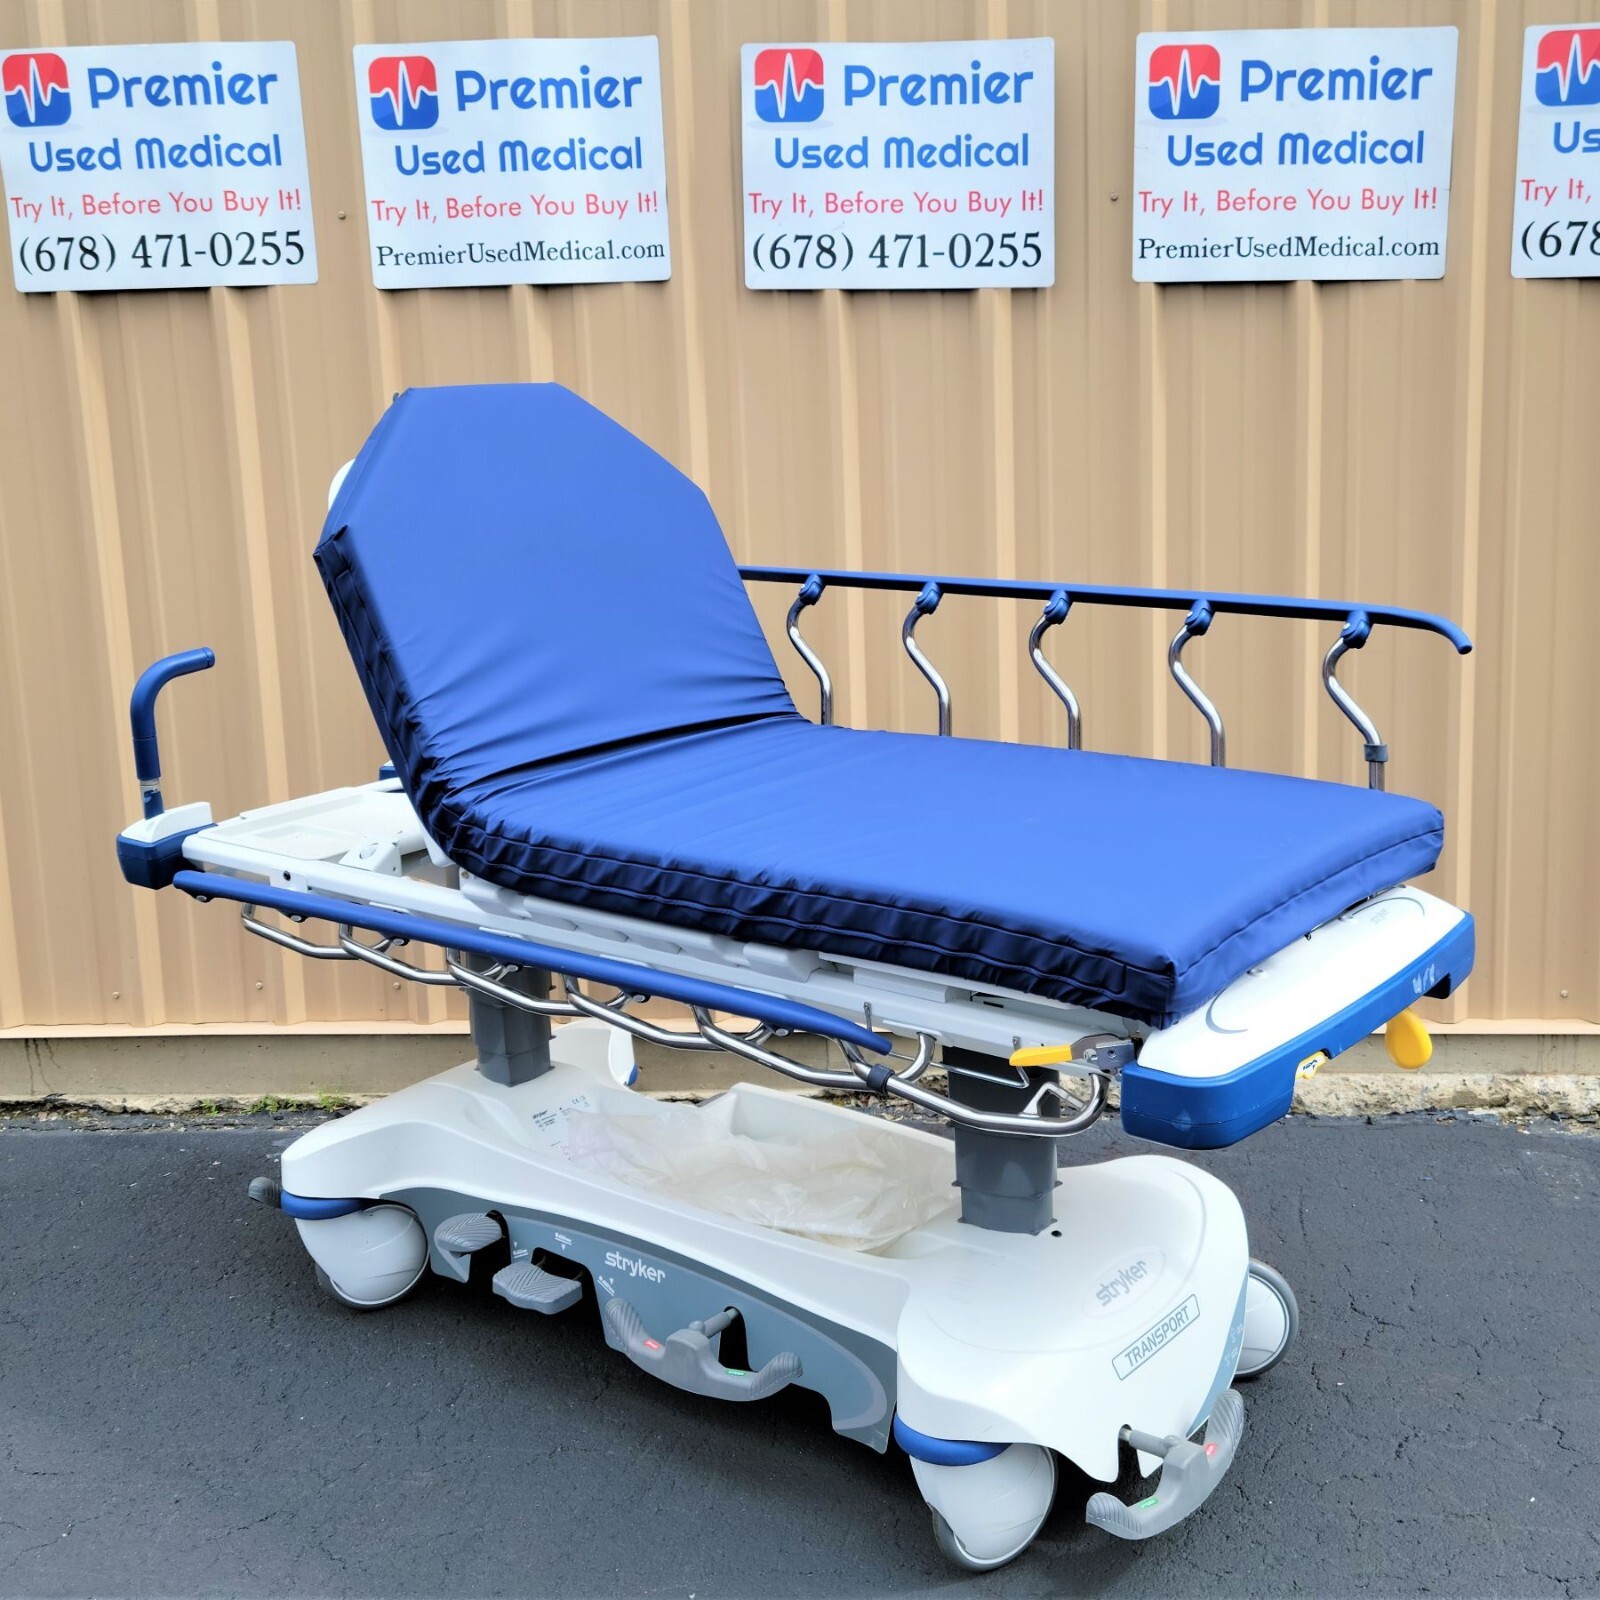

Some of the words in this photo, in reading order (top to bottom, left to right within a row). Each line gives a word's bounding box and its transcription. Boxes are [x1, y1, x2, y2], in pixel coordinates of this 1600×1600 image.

[87, 60, 279, 109] Premier
[455, 64, 643, 112] Premier
[844, 59, 1034, 108] Premier
[1240, 55, 1434, 103] Premier
[29, 137, 122, 173] Used
[135, 133, 282, 170] Medical
[395, 140, 486, 176] Used
[498, 136, 643, 173] Medical
[775, 136, 869, 169] Used
[883, 132, 1029, 169] Medical
[1167, 132, 1263, 167] Used
[1278, 129, 1425, 166] Medical
[11, 197, 42, 223] Try
[51, 197, 73, 219] It,
[82, 192, 160, 216] Before
[169, 191, 214, 213] You
[224, 188, 268, 216] Buy
[278, 189, 300, 210] It!
[371, 199, 406, 227] Try
[416, 199, 438, 222] It,
[446, 195, 522, 219] Before
[530, 194, 574, 216] You
[585, 192, 628, 221] Buy
[638, 191, 658, 212] It!
[748, 192, 782, 220] Try
[792, 192, 813, 218] It,
[824, 190, 905, 214] Before
[914, 191, 957, 214] You
[967, 190, 1012, 218] Buy
[1021, 188, 1044, 212] It!
[1138, 191, 1173, 219] Try
[1183, 191, 1205, 216] It,
[1216, 188, 1297, 212] Before
[1308, 189, 1350, 211] You
[1360, 188, 1405, 215] Buy
[1413, 187, 1438, 209] It!
[1521, 179, 1558, 207] Try
[1568, 178, 1592, 203] It,
[19, 235, 116, 274] (678)
[131, 230, 304, 268] 471-0255
[377, 240, 665, 266] PremierUsedMedical.com
[753, 233, 854, 271] (678)
[868, 231, 1042, 268] 471-0255
[1139, 236, 1439, 259] PremierUsedMedical.com
[605, 1251, 666, 1283] stryker
[1096, 1260, 1148, 1307] stryker
[1124, 1305, 1190, 1367] TRANSPORT
